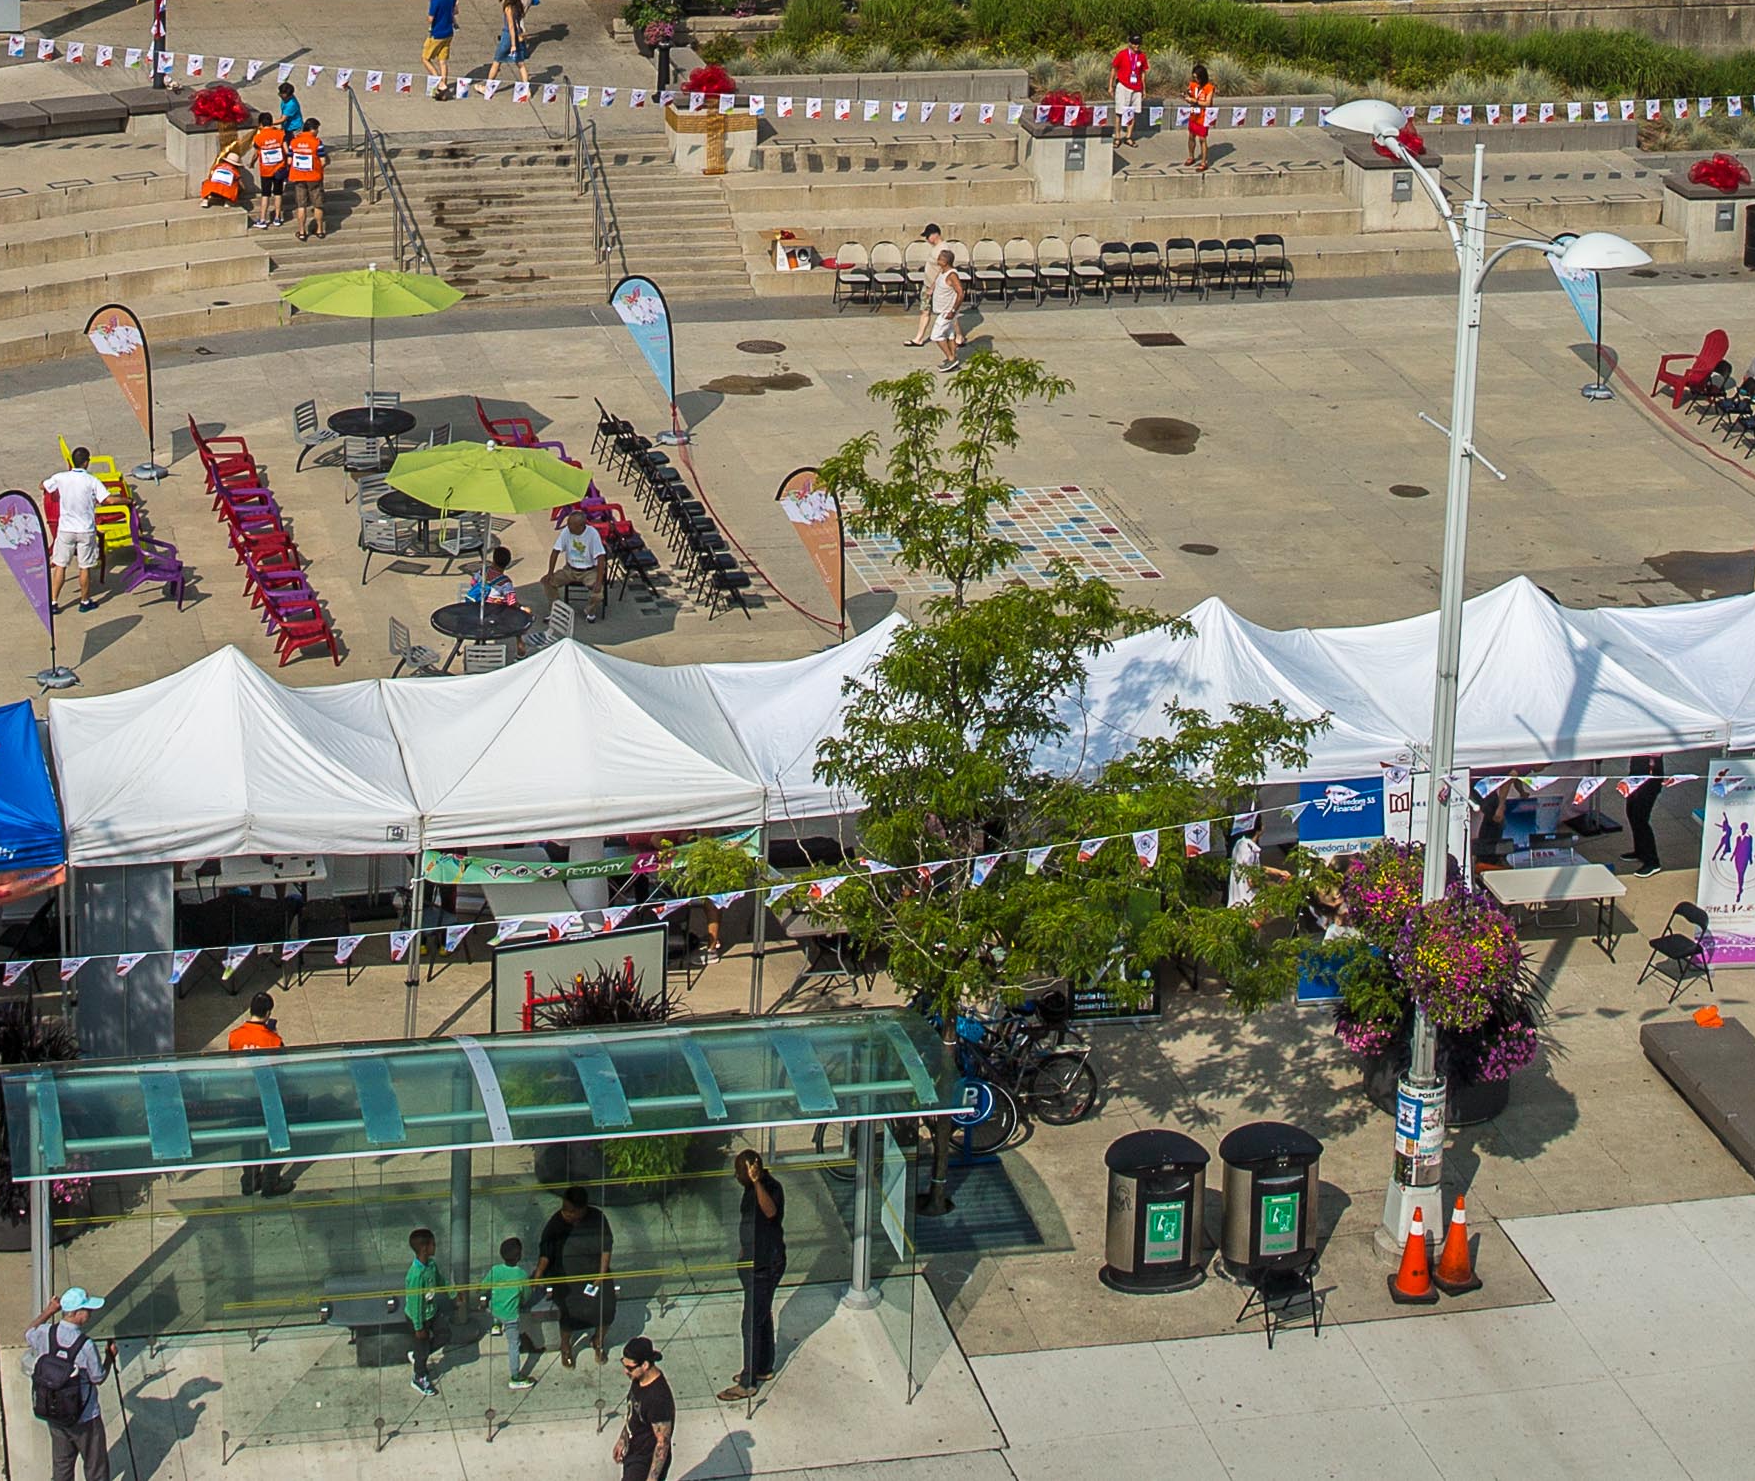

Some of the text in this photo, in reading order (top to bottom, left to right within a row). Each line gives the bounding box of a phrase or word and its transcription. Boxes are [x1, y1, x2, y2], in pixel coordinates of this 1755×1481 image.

[1333, 805, 1363, 813] Financial
[1310, 844, 1345, 853] Freedom
[1346, 843, 1358, 852] for
[566, 861, 625, 877] FESTIVITY
